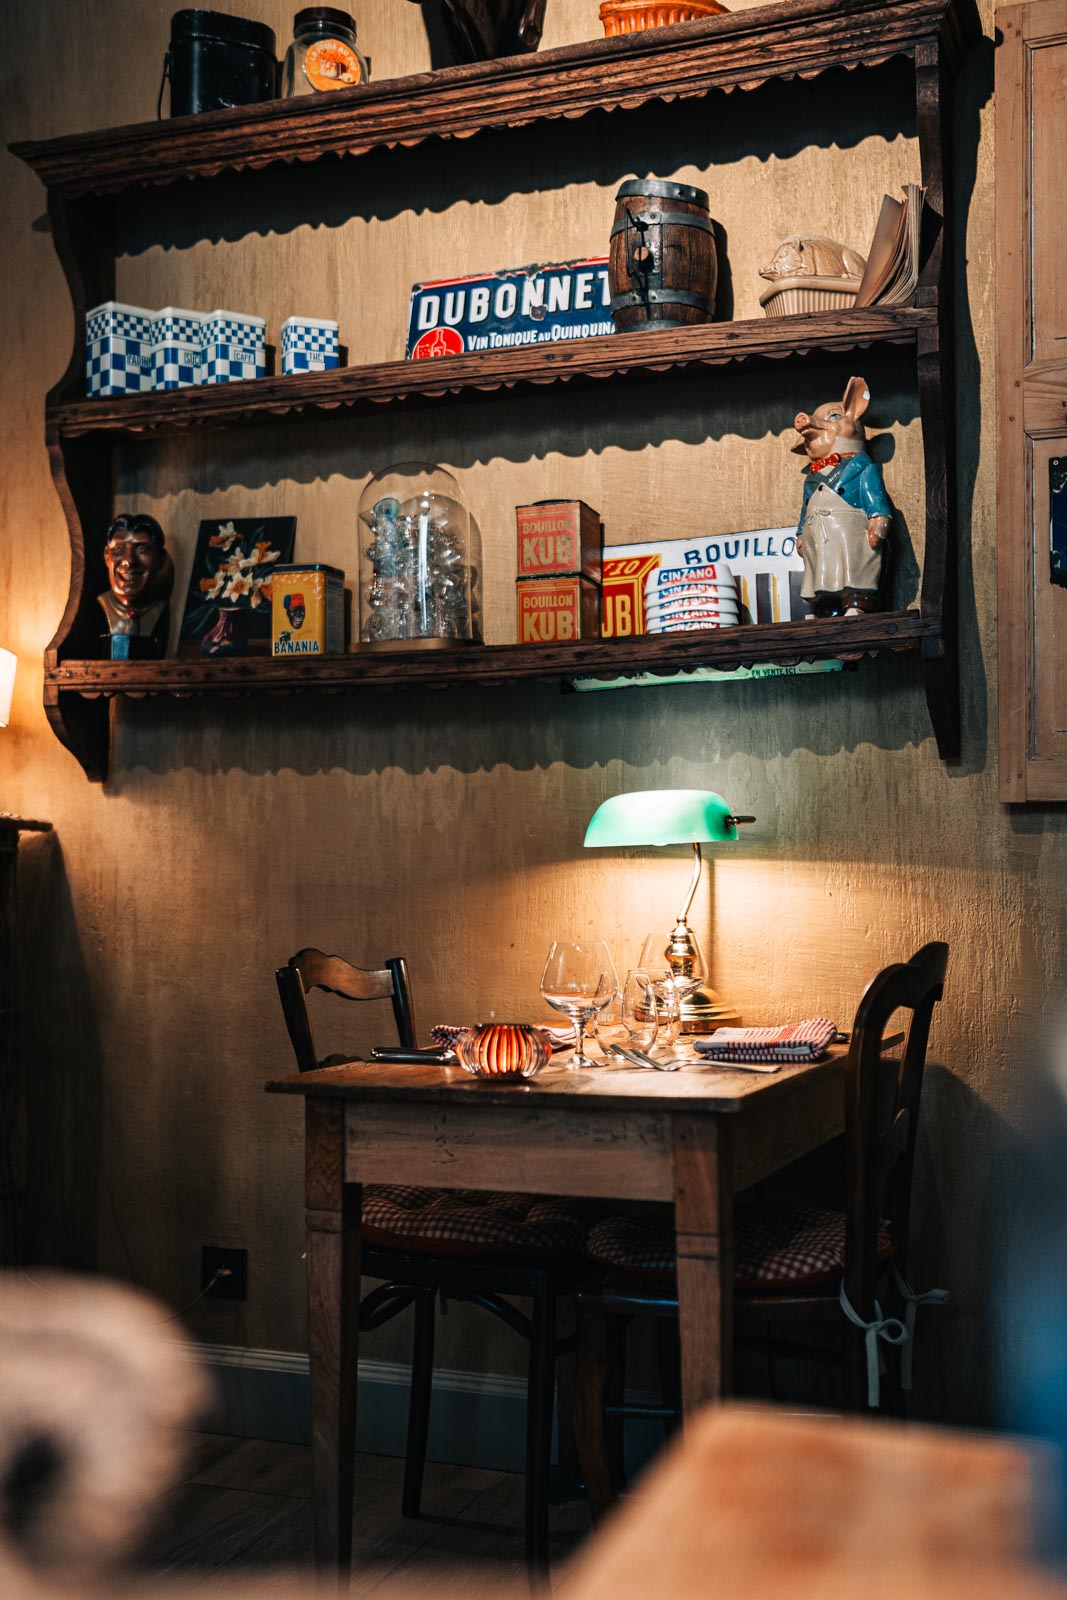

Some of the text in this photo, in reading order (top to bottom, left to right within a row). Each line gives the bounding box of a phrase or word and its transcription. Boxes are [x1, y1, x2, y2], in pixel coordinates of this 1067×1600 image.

[418, 270, 611, 331] DUBONNET
[488, 329, 538, 348] TONIQUE
[538, 332, 551, 342] AU
[186, 352, 201, 366] SUC
[522, 518, 571, 534] BOUILLON
[523, 535, 571, 568] KUB
[684, 537, 797, 565] BOUILLO
[609, 560, 640, 576] 10
[660, 567, 714, 582] CINZANO
[523, 595, 573, 609] BOUILLON
[601, 595, 631, 638] UB
[523, 611, 573, 641] KUB
[274, 640, 319, 654] BANANIA
